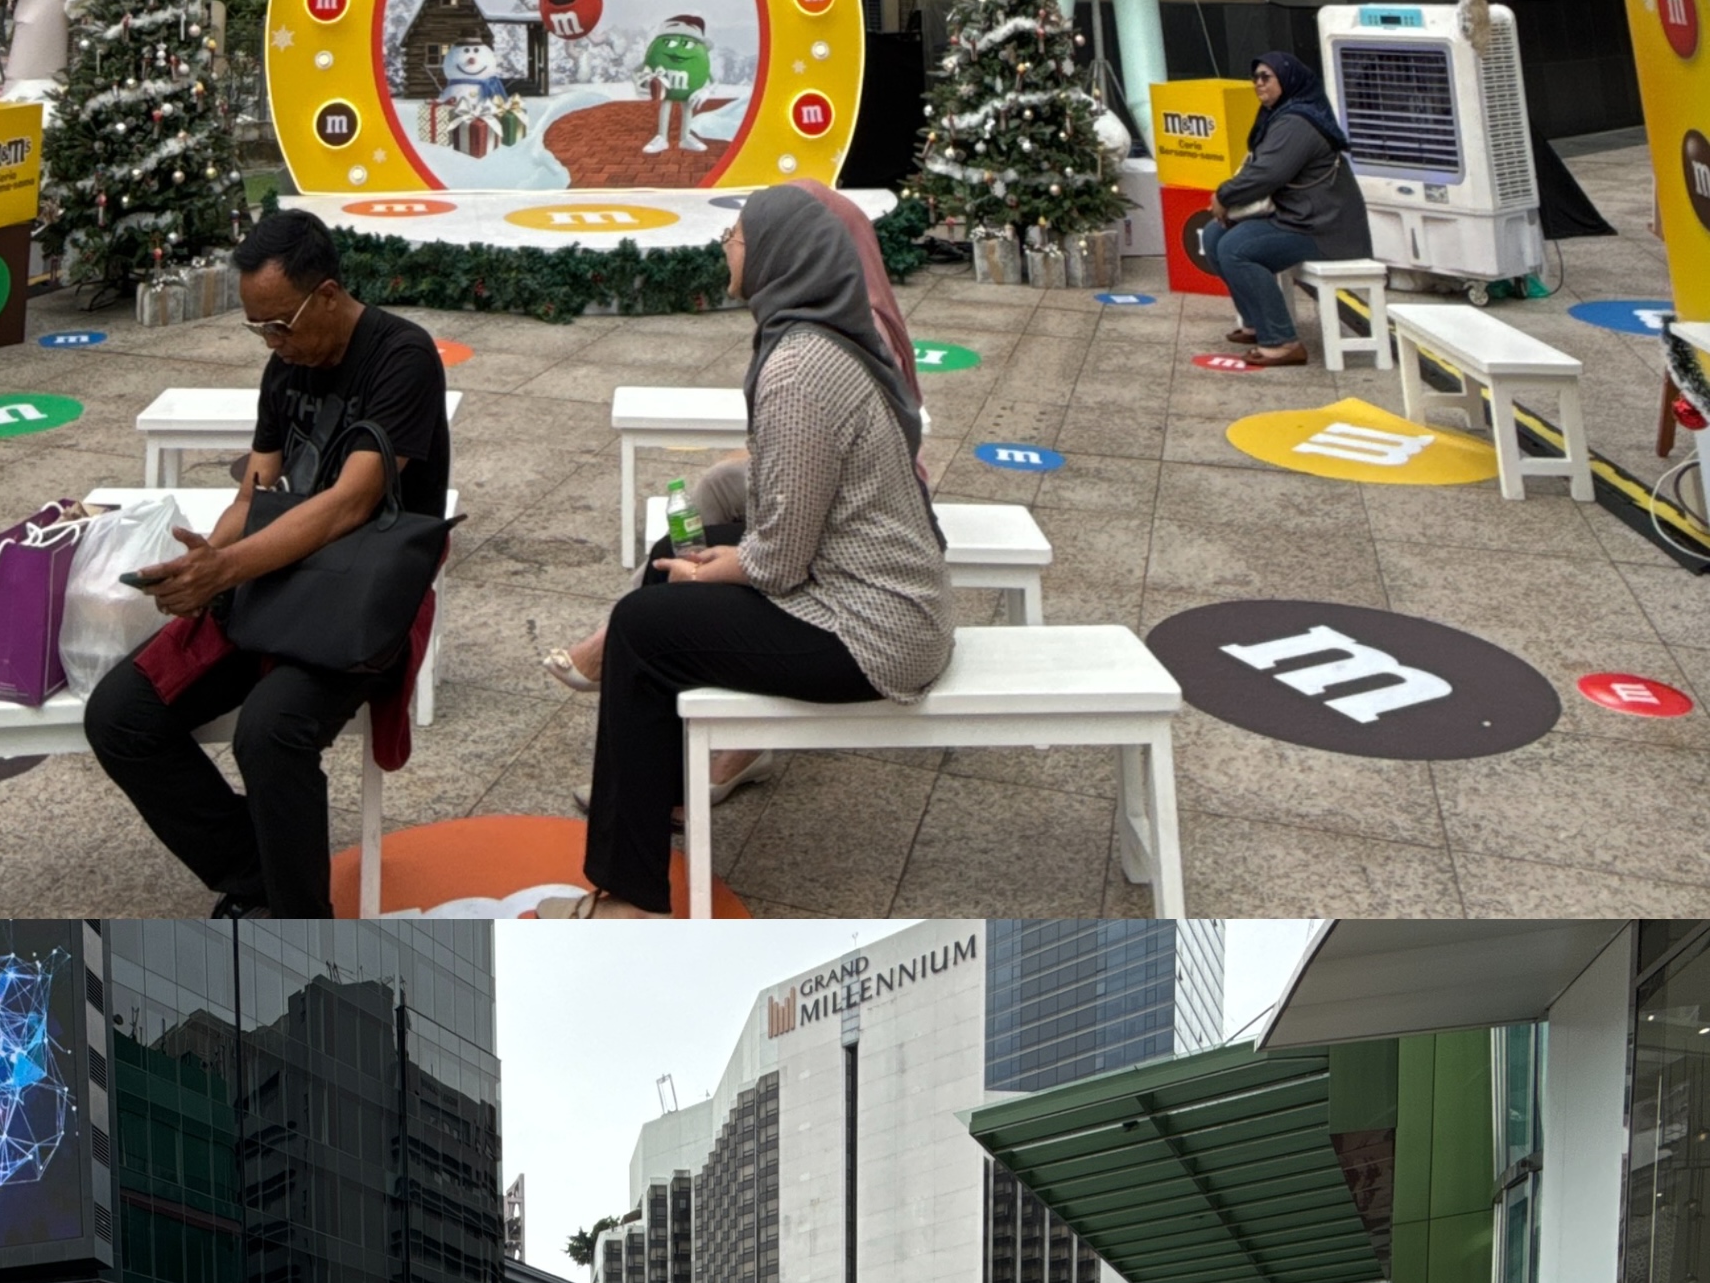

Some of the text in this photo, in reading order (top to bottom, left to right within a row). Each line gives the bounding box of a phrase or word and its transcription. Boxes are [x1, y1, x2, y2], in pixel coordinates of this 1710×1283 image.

[1220, 625, 1452, 723] m
[800, 956, 870, 996] GRAND
[800, 935, 978, 1027] MILLENNIUM
